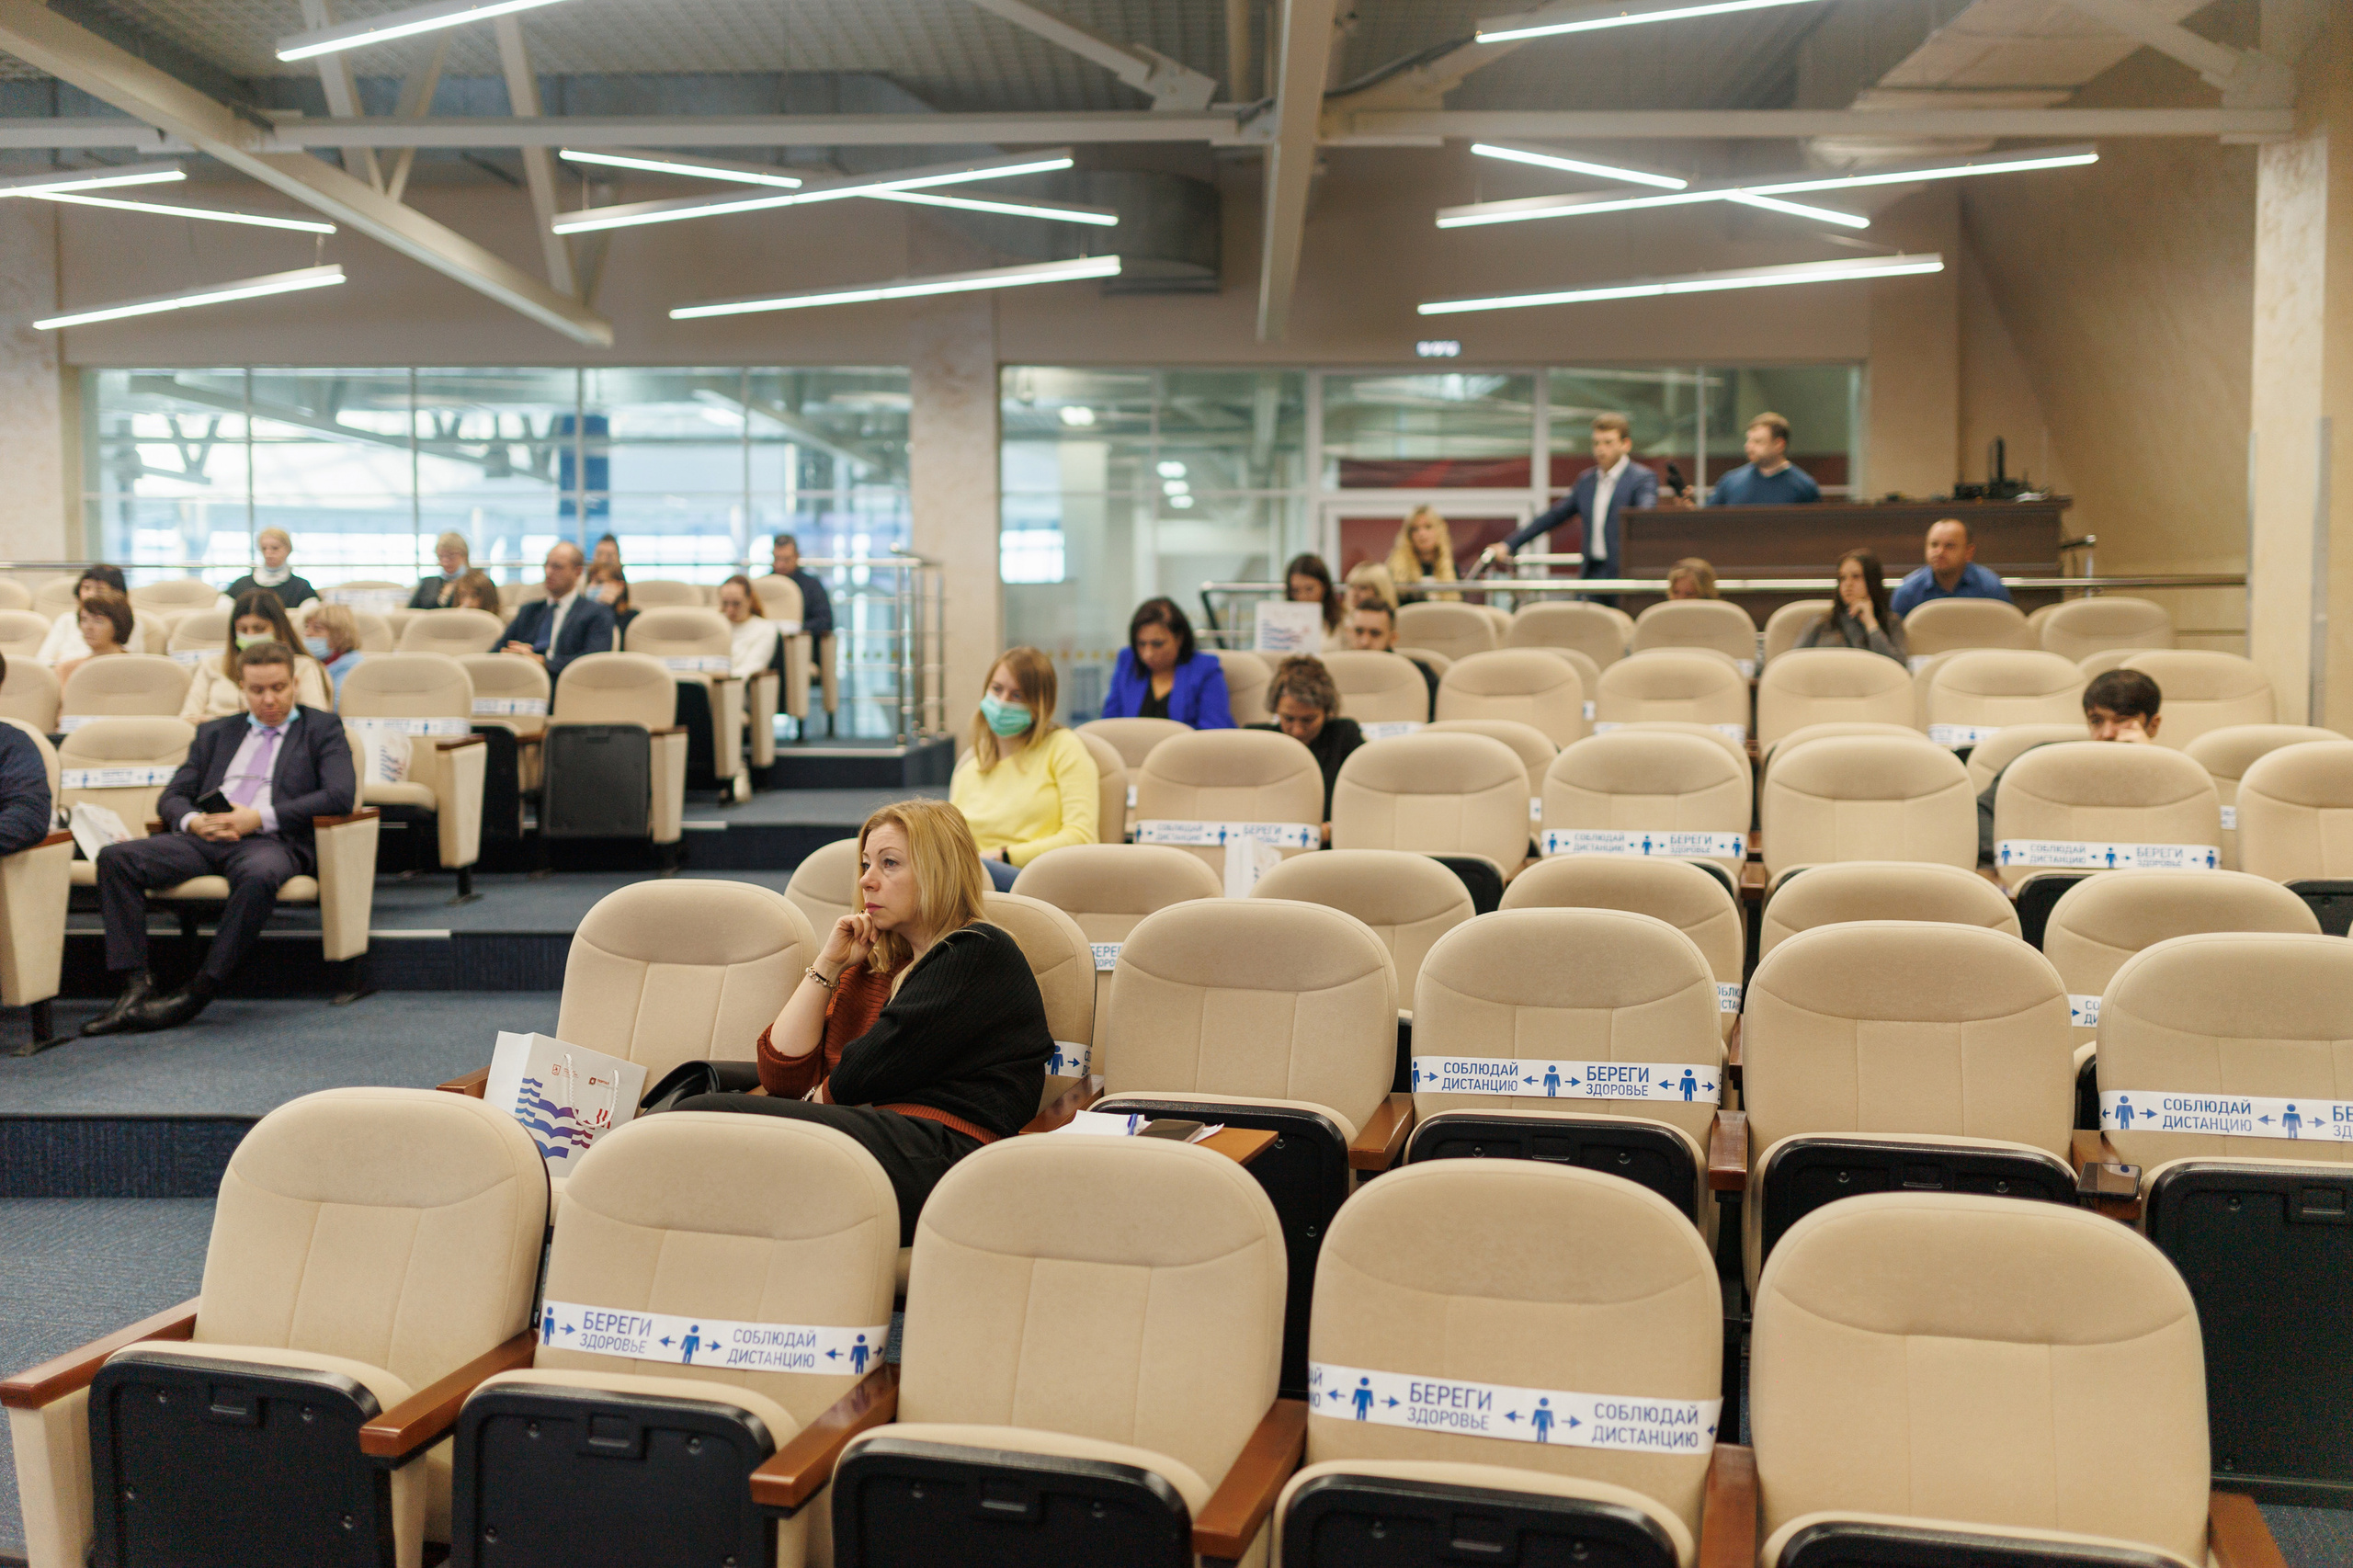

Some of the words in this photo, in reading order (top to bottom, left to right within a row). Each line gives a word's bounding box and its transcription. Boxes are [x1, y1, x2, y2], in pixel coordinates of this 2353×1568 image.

[1670, 834, 1712, 845] БЕРЕГИ
[2137, 846, 2183, 858] БЕРЕГИ
[1443, 1062, 1518, 1077] СОБЛЮДАЙ
[1586, 1065, 1649, 1083] БЕРЕГИ
[1441, 1077, 1518, 1093] ДИСТАНЦИЮ
[1586, 1083, 1649, 1096] ЗДОРОВЬЕ
[2163, 1097, 2252, 1116] СОБЛЮДАЙ
[2162, 1115, 2252, 1132] ДИСТАНЦИЮ
[2333, 1124, 2353, 1139] ЗД
[583, 1311, 653, 1336] БЕРЕГИ
[579, 1333, 647, 1354] ЗДОРОВЬЕ
[733, 1328, 816, 1349] СОБЛЮДАЙ
[726, 1348, 815, 1369] ДИСТАНЦИЮ
[1409, 1382, 1493, 1411] БЕРЕГИ
[1407, 1407, 1489, 1431] ЗДОРОВЬЕ
[1595, 1403, 1699, 1426] СОБЛЮДАЙ
[1591, 1426, 1699, 1449] ДИСТАНЦИЮ
